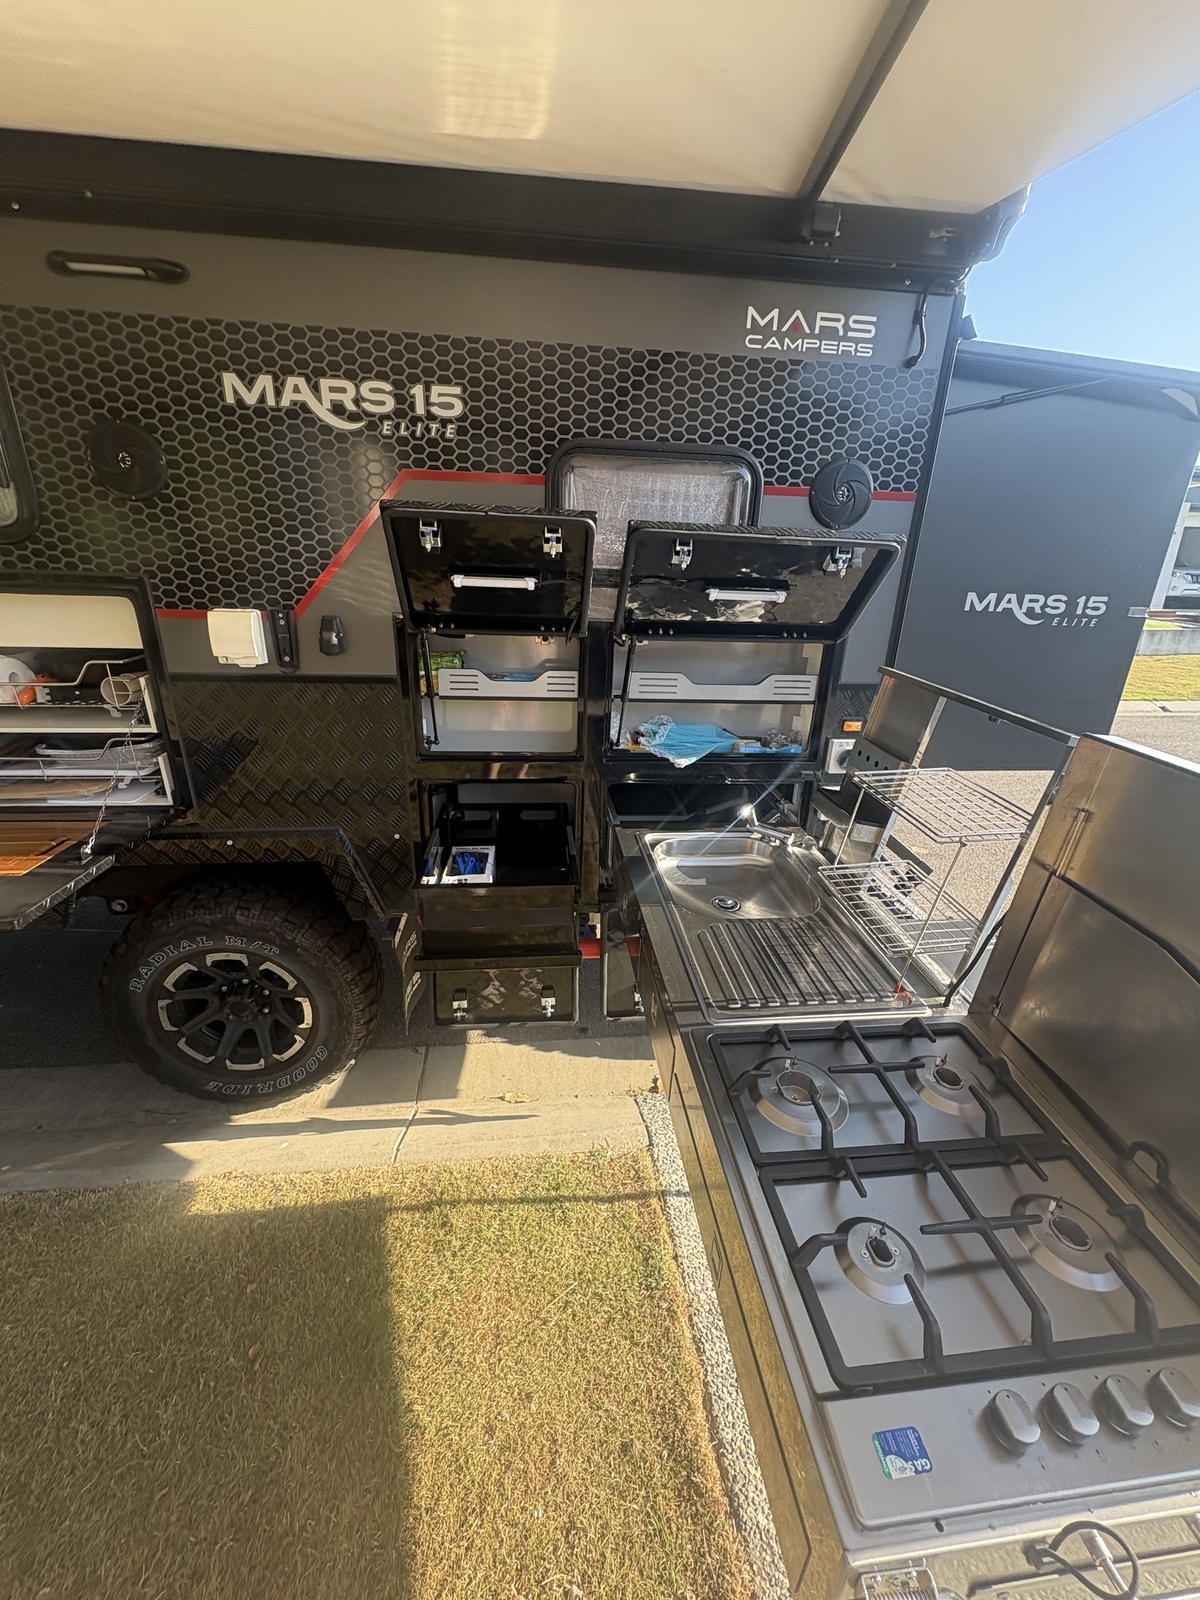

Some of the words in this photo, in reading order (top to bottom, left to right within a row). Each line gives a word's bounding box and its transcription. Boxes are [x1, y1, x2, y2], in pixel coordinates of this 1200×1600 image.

[745, 305, 878, 339] MARS
[745, 334, 874, 357] CAMPERS
[222, 372, 396, 430] MARS
[410, 384, 464, 418] 15
[382, 420, 456, 438] ELITE
[963, 591, 1068, 625] MARS
[1075, 595, 1109, 616] 15
[1051, 617, 1098, 627] ELITE
[129, 936, 213, 992] RADIAL
[225, 935, 280, 956] M/T
[204, 1046, 328, 1095] GOODRIDE
[907, 1458, 931, 1473] GAS
